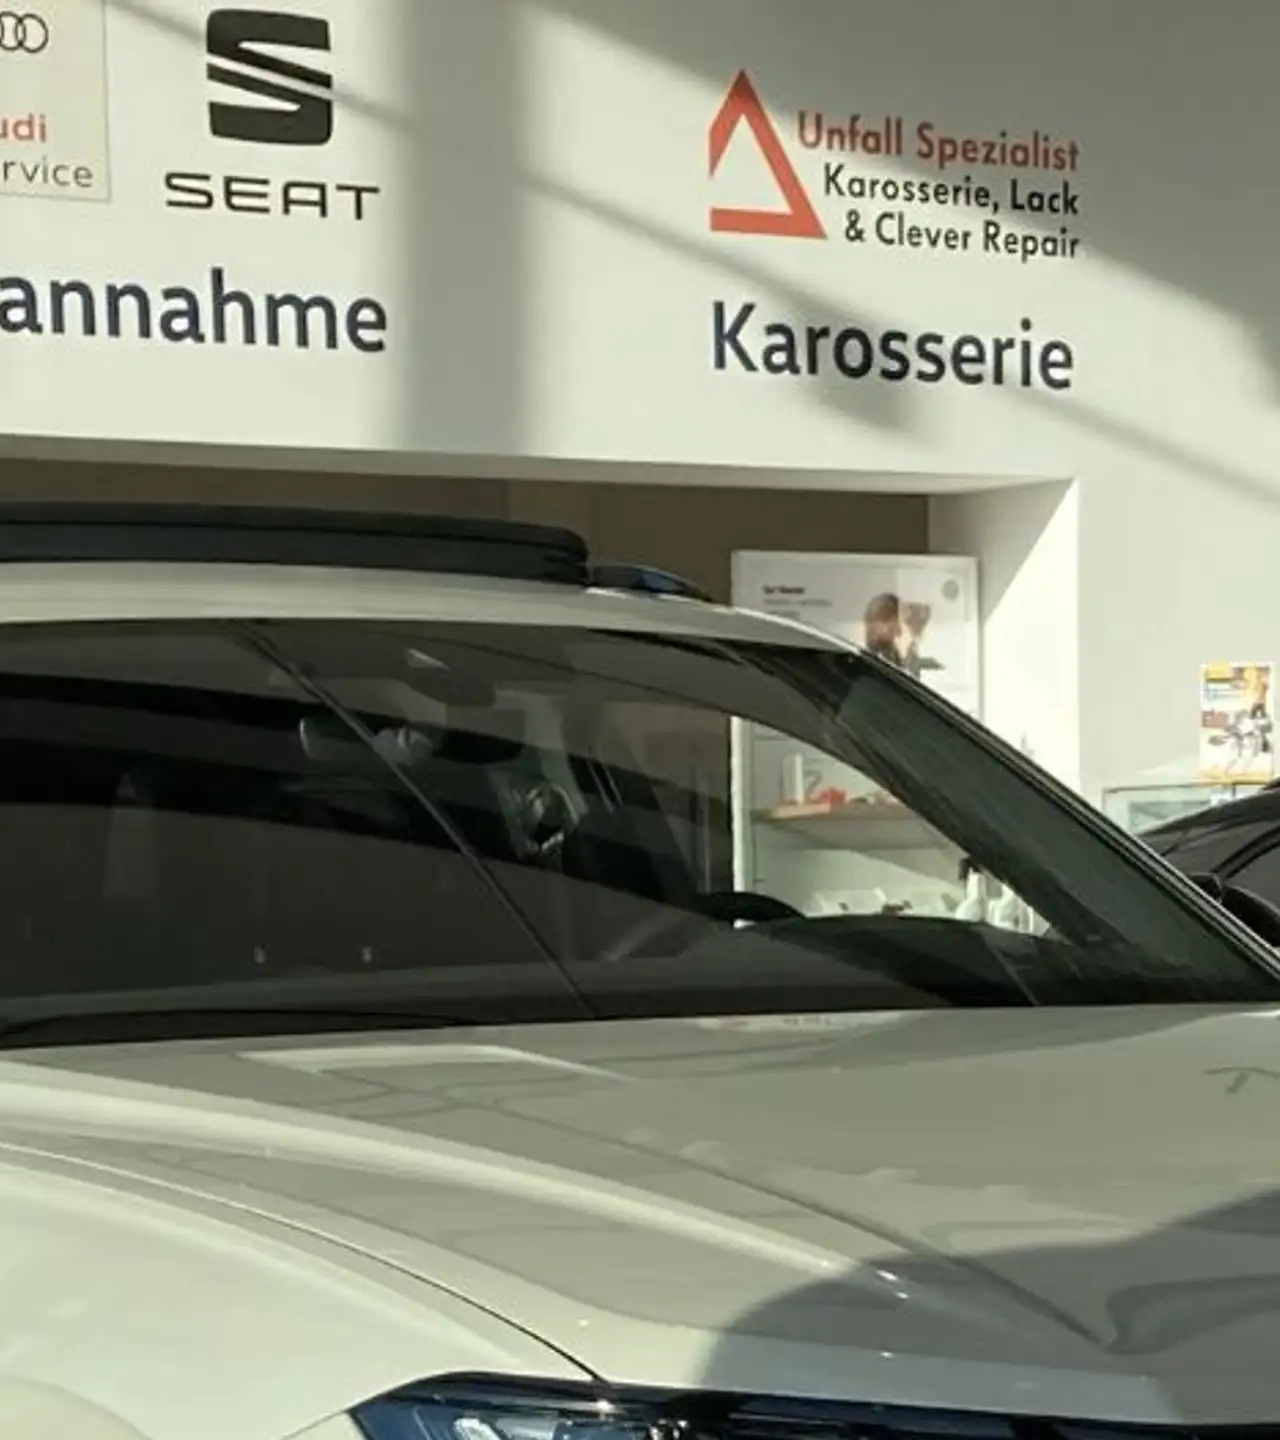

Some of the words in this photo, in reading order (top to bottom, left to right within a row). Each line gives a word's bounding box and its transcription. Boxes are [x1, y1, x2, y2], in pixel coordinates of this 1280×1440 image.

[797, 110, 904, 157] Unfall
[915, 122, 1080, 172] Spezialist
[164, 172, 381, 221] SEAT
[824, 162, 1001, 214] Karosserie,
[1010, 180, 1080, 217] Lack
[844, 209, 866, 243] &
[875, 211, 972, 253] Clever
[983, 222, 1081, 264] Repair
[712, 300, 1074, 391] Karosserie
